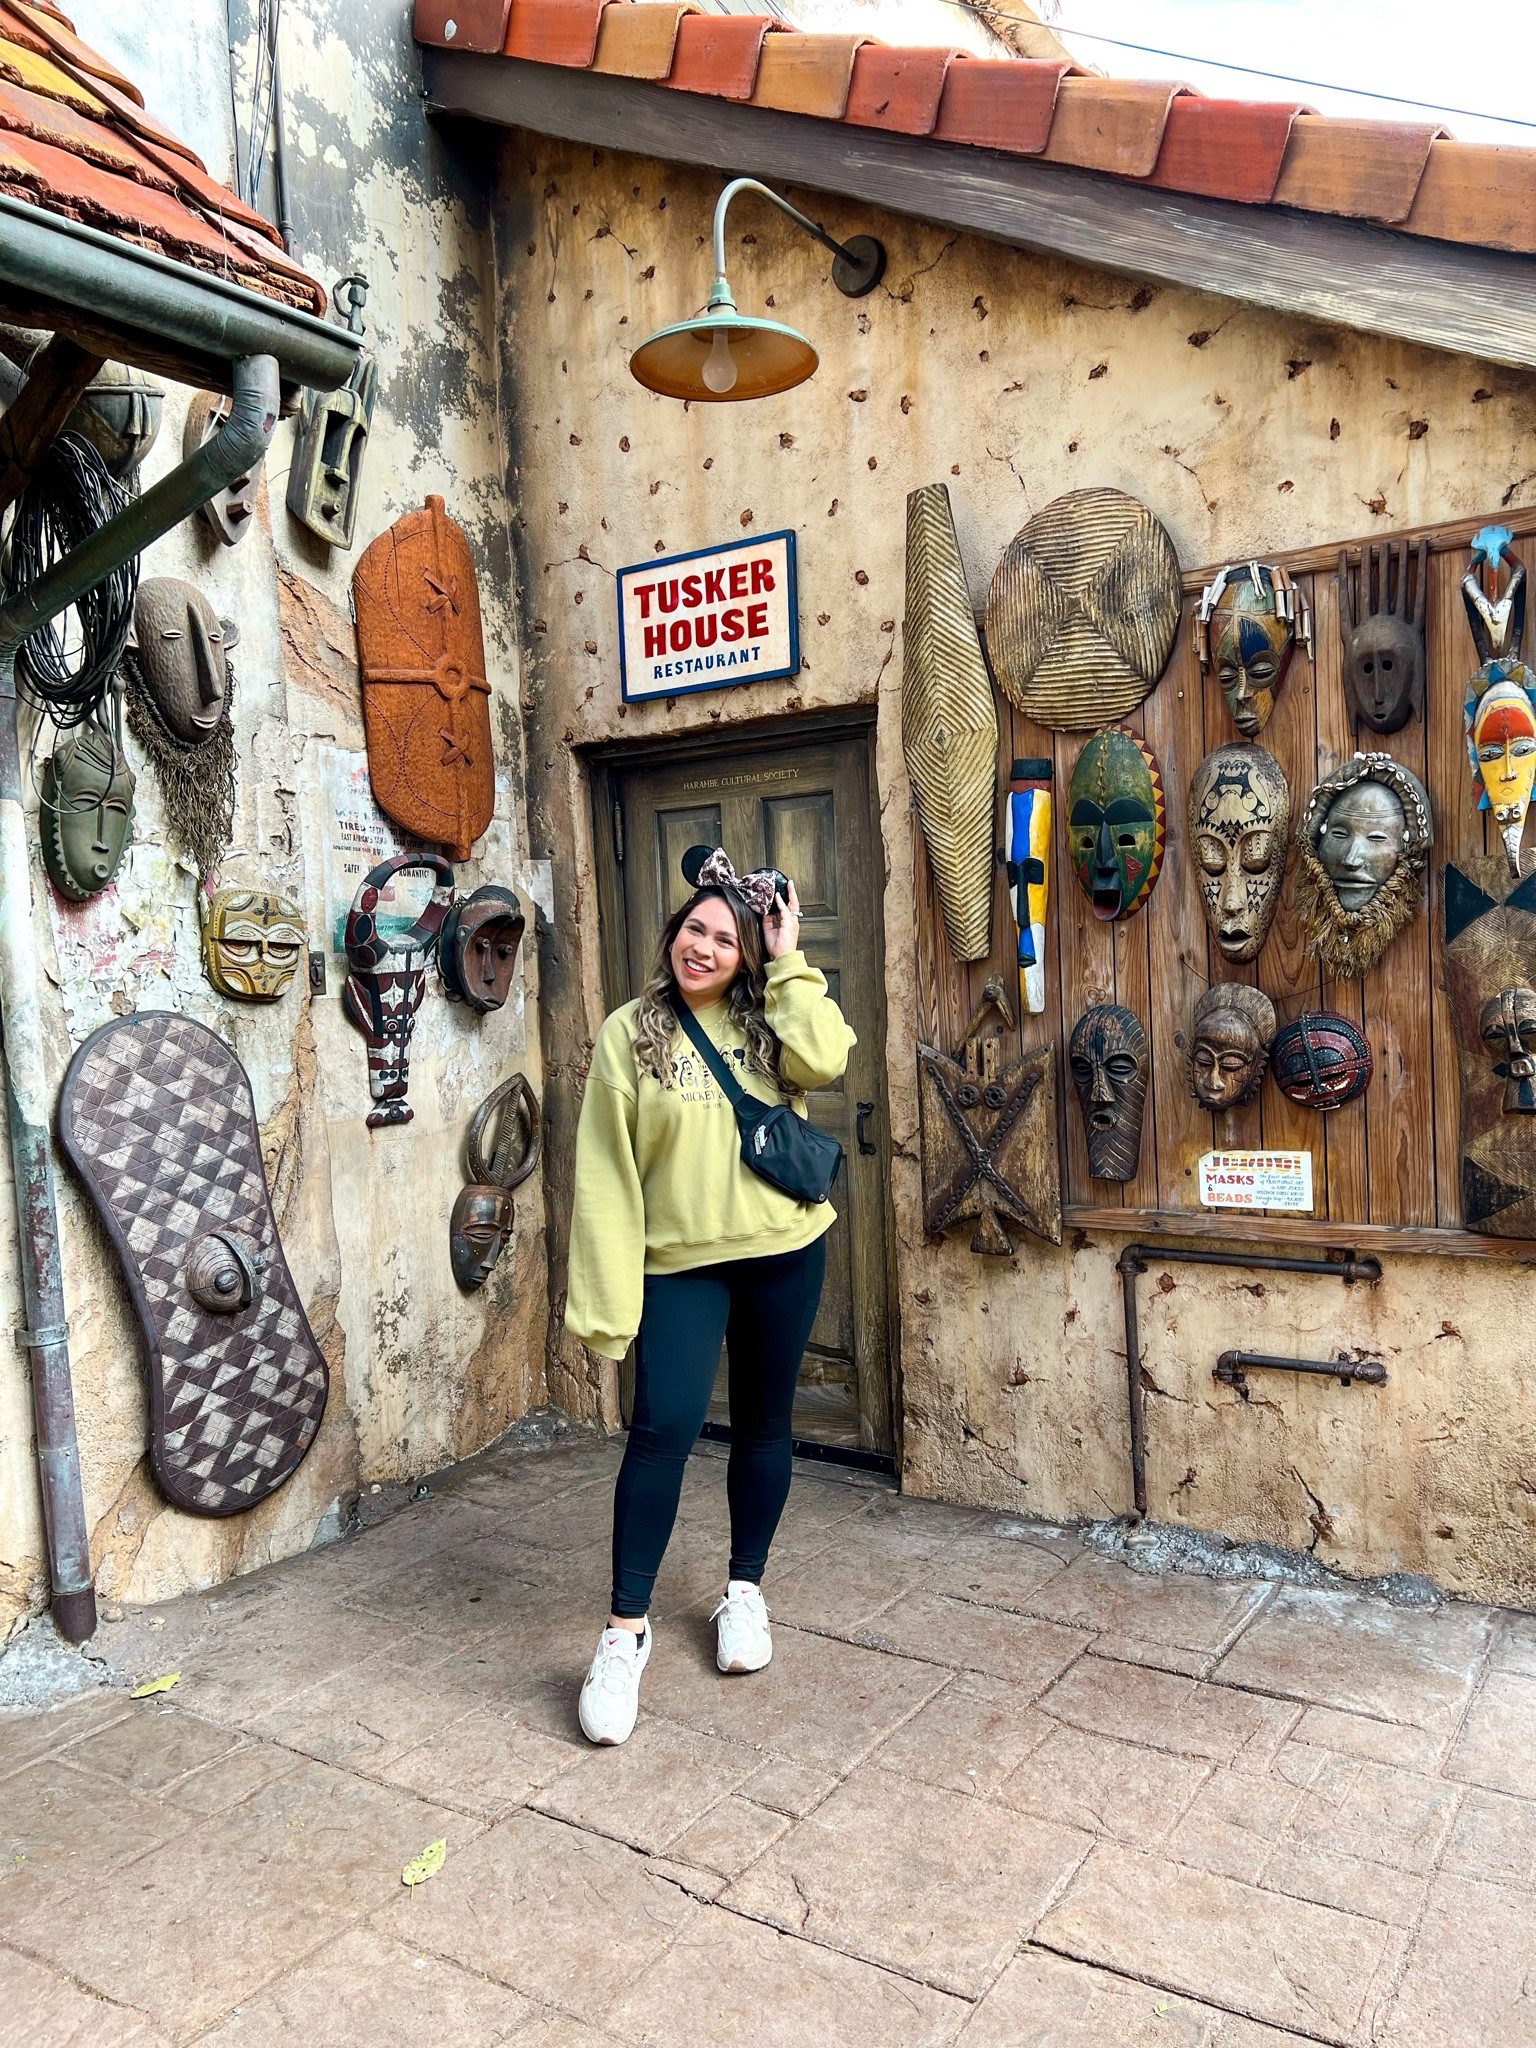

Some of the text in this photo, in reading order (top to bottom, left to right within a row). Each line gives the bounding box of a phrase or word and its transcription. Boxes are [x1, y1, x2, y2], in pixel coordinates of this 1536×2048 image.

[633, 558, 776, 619] TUSKER
[643, 602, 770, 658] HOUSE
[653, 646, 761, 680] RESTAURANT
[683, 768, 800, 791] HARAMBE CULTURAL SOCIETY
[681, 1090, 715, 1103] MICKEY
[1205, 1173, 1255, 1186] MASKS
[1207, 1183, 1214, 1192] &
[1207, 1192, 1253, 1204] BEADS
